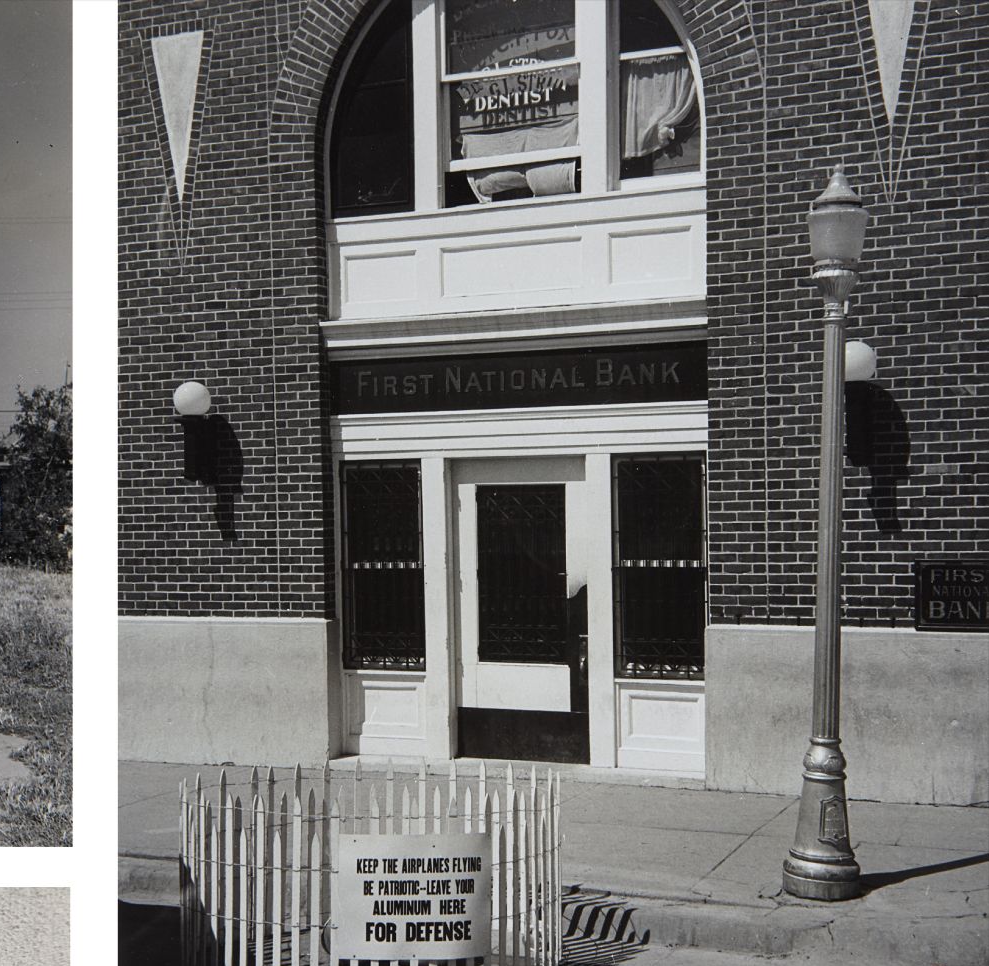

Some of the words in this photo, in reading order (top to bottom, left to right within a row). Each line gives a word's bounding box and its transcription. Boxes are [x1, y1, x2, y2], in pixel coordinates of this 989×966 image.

[474, 87, 552, 112] DENTIST
[357, 371, 434, 398] FIRST
[444, 365, 585, 393] NATIONAL
[595, 358, 681, 387] BANK
[931, 569, 989, 583] FIRS
[356, 858, 379, 874] KEEP
[382, 858, 398, 874] THE
[402, 857, 450, 874] AIRPLANES
[452, 856, 482, 873] FLYING
[363, 880, 374, 895] BE
[455, 879, 475, 894] YOUR
[372, 900, 431, 916] ALUMINUM
[439, 899, 466, 915] HERE
[366, 922, 397, 942] FOR
[405, 920, 472, 942] DEFENSE
